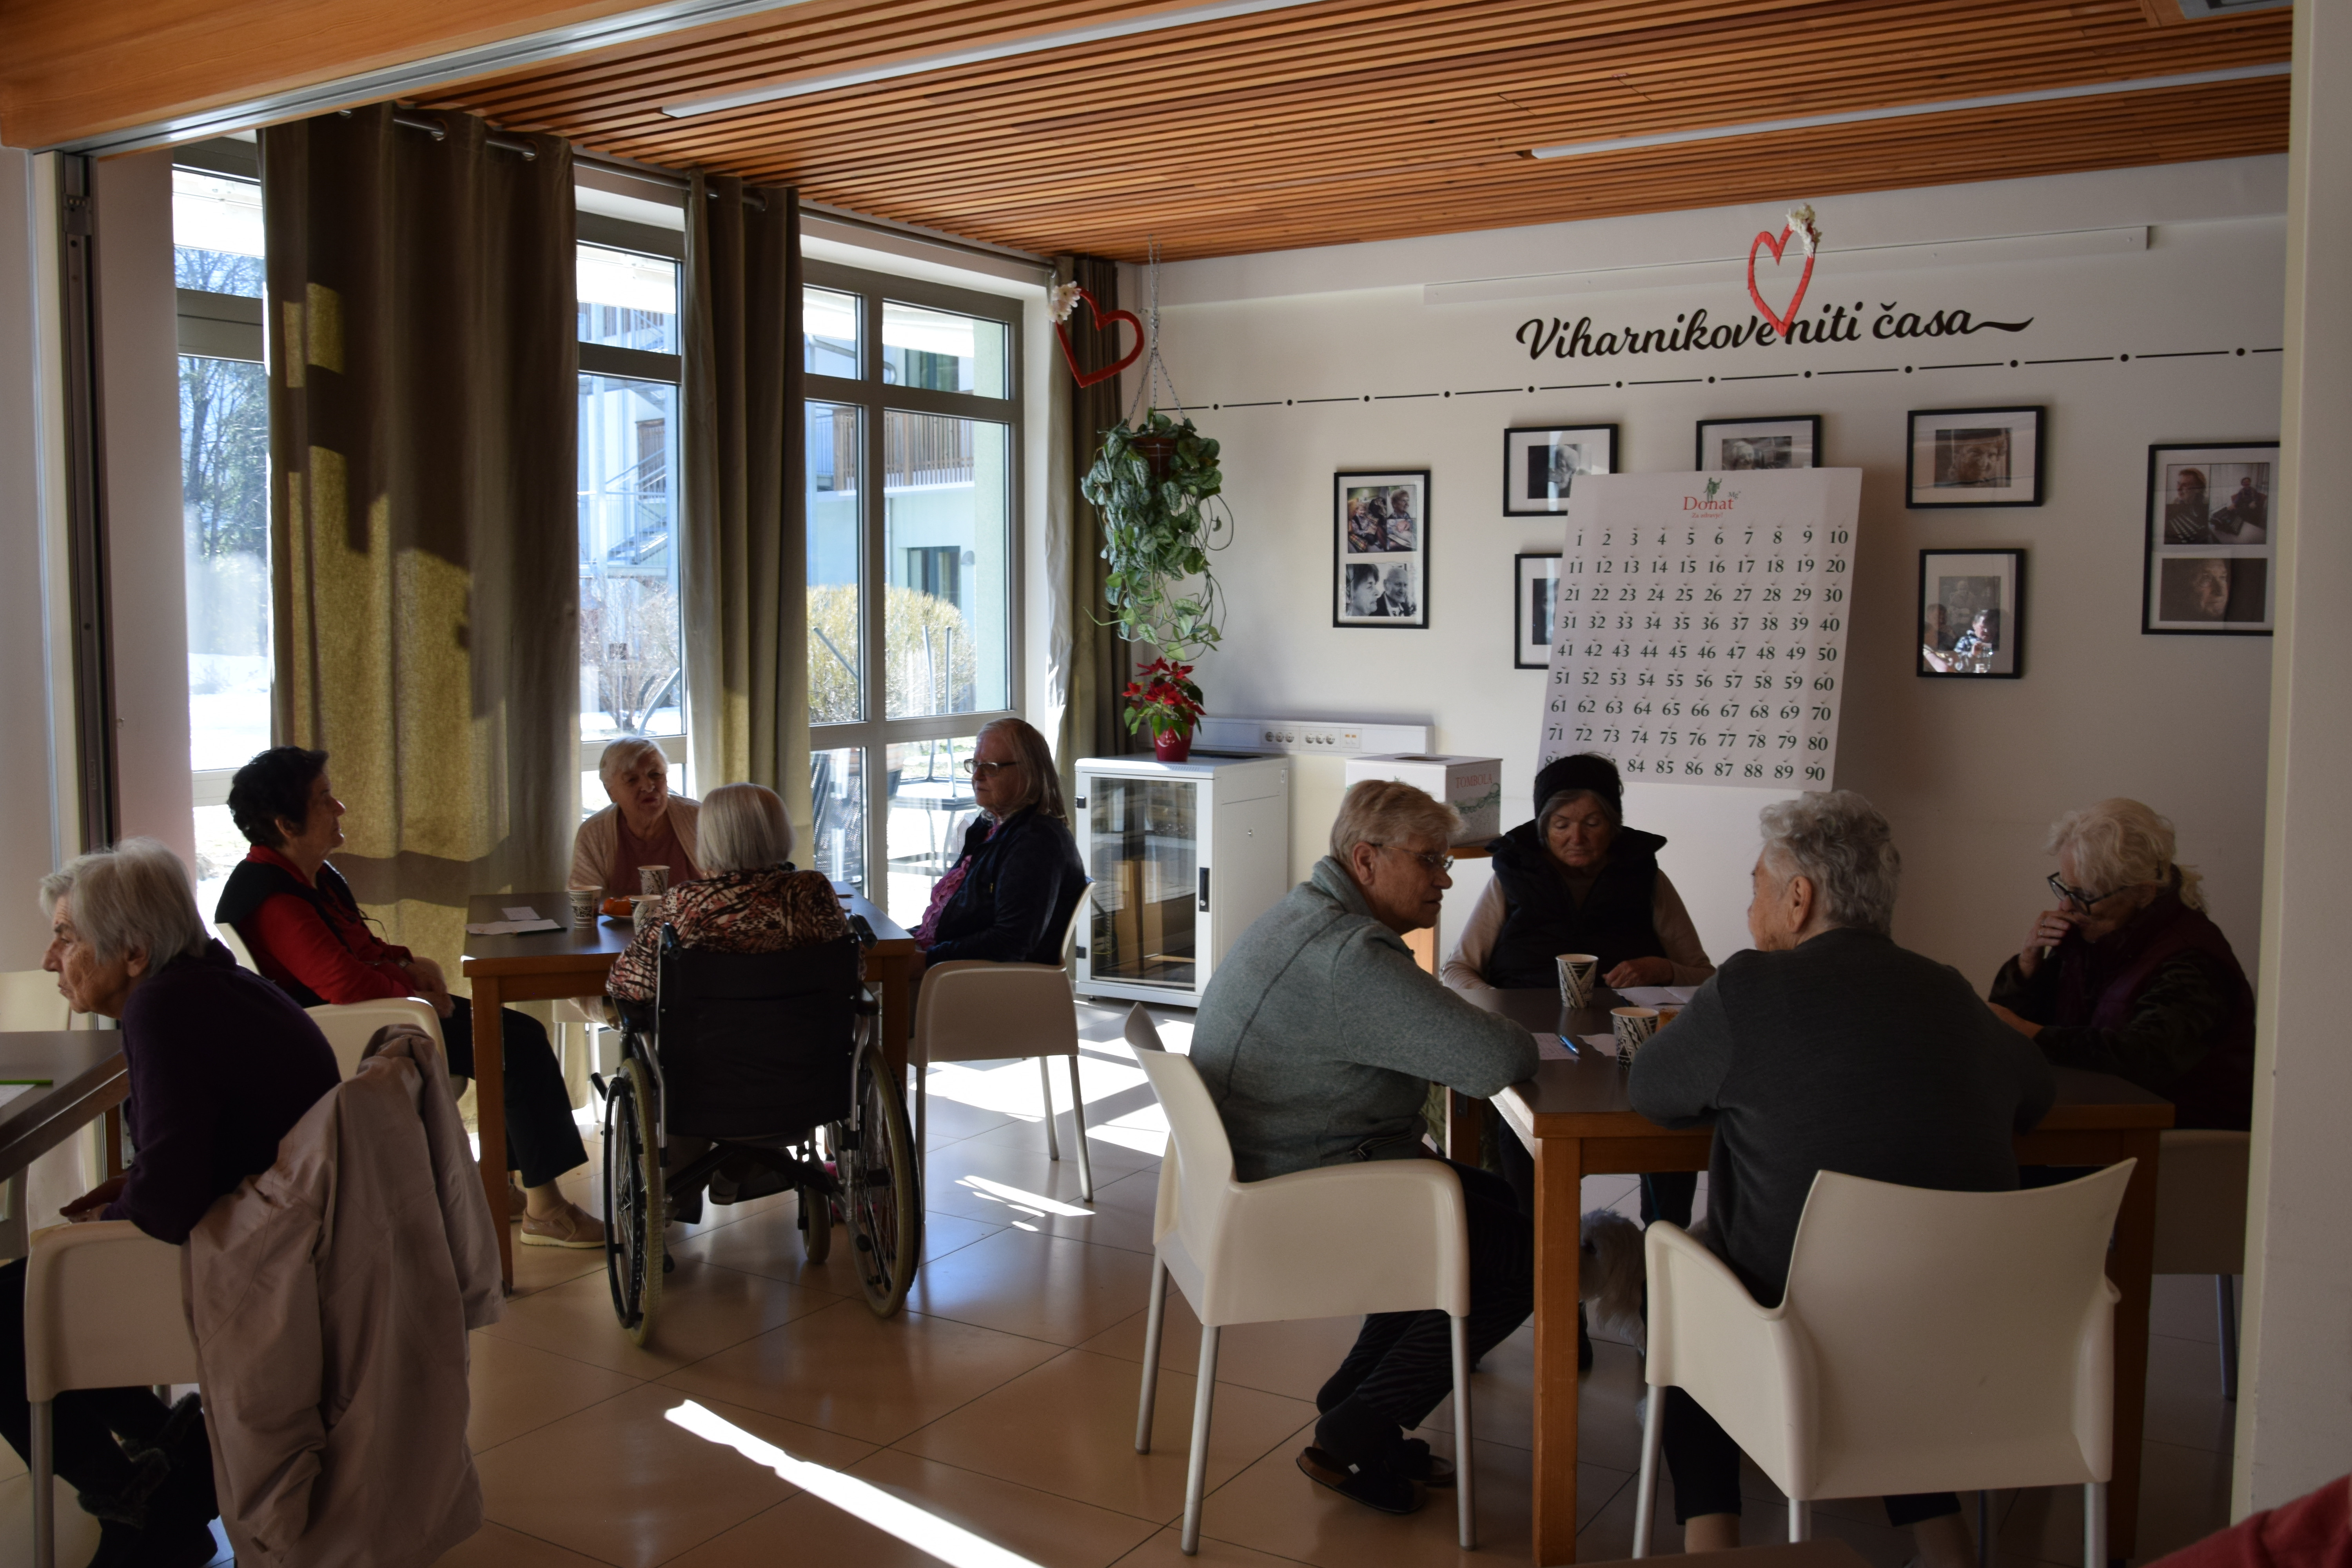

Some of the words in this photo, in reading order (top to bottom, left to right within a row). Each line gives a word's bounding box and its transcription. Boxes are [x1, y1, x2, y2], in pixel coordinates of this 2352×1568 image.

[1515, 308, 1777, 360] Viharnikove
[1785, 301, 1864, 345] niti
[1872, 301, 2034, 339] časa
[1683, 496, 1734, 510] Donat
[1577, 534, 1582, 546] 1
[1602, 533, 1611, 546] 2
[1631, 533, 1638, 546] 3
[1657, 534, 1666, 545] 4
[1687, 532, 1695, 545] 5
[1714, 532, 1724, 544] 6
[1745, 532, 1753, 544] 7
[1773, 531, 1782, 544] 8
[1803, 530, 1813, 543] 9
[1831, 530, 1848, 544] 10
[1570, 561, 1583, 573] 11
[1597, 561, 1612, 573] 12
[1624, 561, 1639, 573] 13
[1652, 561, 1668, 573] 14
[1681, 560, 1696, 573] 15
[1709, 561, 1725, 573] 16
[1738, 560, 1755, 573] 17
[1768, 559, 1784, 573] 18
[1797, 559, 1815, 572] 19
[1826, 559, 1846, 573] 20
[1564, 588, 1579, 601] 21
[1591, 588, 1609, 601] 22
[1619, 588, 1636, 601] 23
[1647, 588, 1664, 601] 24
[1675, 588, 1693, 601] 25
[1704, 588, 1722, 601] 26
[1733, 588, 1752, 601] 27
[1763, 588, 1781, 601] 28
[1792, 588, 1812, 601] 29
[1824, 588, 1843, 602] 30
[1562, 616, 1576, 629] 31
[1589, 616, 1606, 629] 32
[1616, 616, 1633, 629] 33
[1644, 616, 1661, 629] 34
[1673, 617, 1690, 630] 35
[1702, 617, 1719, 630] 36
[1731, 617, 1749, 630] 37
[1760, 617, 1778, 630] 38
[1791, 617, 1809, 631] 39
[1820, 618, 1840, 632] 40
[1557, 644, 1573, 656] 41
[1584, 644, 1602, 657] 42
[1612, 644, 1630, 657] 43
[1640, 645, 1658, 658] 44
[1669, 645, 1687, 658] 45
[1697, 646, 1716, 659] 46
[1727, 646, 1746, 659] 47
[1756, 646, 1775, 659] 48
[1786, 647, 1806, 660] 49
[1818, 647, 1837, 661] 50
[1555, 671, 1570, 684] 51
[1582, 672, 1599, 684] 52
[1609, 672, 1626, 686] 53
[1637, 673, 1655, 686] 54
[1666, 673, 1684, 687] 55
[1695, 674, 1713, 688] 56
[1724, 675, 1743, 688] 57
[1754, 675, 1772, 689] 58
[1784, 676, 1803, 690] 59
[1813, 677, 1834, 691] 60
[1551, 700, 1566, 712] 61
[1577, 700, 1595, 713] 62
[1605, 701, 1623, 714] 63
[1633, 702, 1651, 715] 64
[1662, 702, 1681, 716] 65
[1691, 704, 1710, 717] 66
[1720, 704, 1740, 717] 67
[1750, 705, 1769, 718] 68
[1780, 706, 1800, 719] 69
[1812, 706, 1831, 720] 70
[1549, 728, 1563, 740] 71
[1575, 728, 1592, 741] 72
[1603, 729, 1620, 742] 73
[1632, 730, 1648, 744] 74
[1660, 731, 1677, 745] 75
[1689, 732, 1706, 746] 76
[1719, 733, 1737, 747] 77
[1748, 734, 1766, 748] 78
[1779, 735, 1797, 749] 79
[1808, 737, 1828, 751] 80
[1627, 759, 1645, 773] 84
[1656, 760, 1674, 774] 85
[1685, 761, 1703, 775] 86
[1714, 763, 1733, 777] 87
[1744, 764, 1763, 778] 88
[1774, 765, 1794, 779] 89
[1805, 766, 1825, 781] 90
[1455, 773, 1493, 788] TOMBOLA
